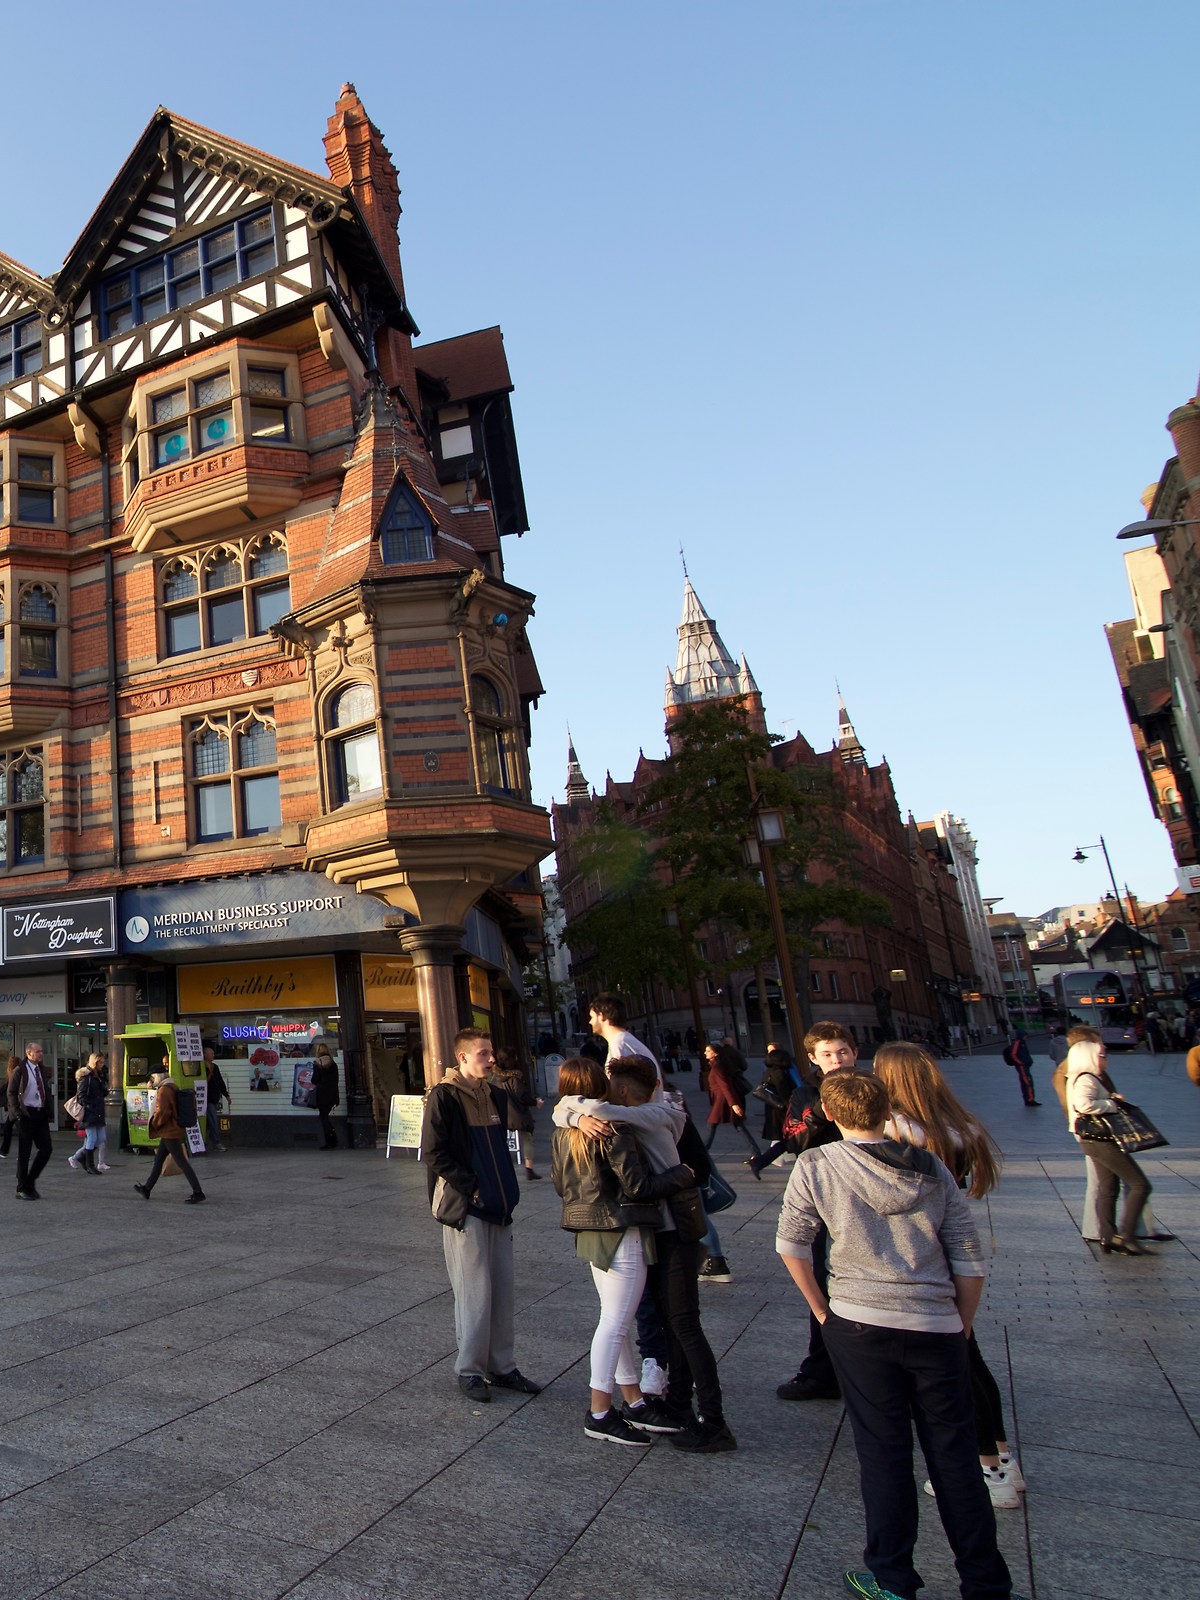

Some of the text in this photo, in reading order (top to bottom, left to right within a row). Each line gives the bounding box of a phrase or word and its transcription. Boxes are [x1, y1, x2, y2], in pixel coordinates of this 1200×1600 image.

[154, 896, 343, 927] MERIDIAN BUSINESS SUPPORT
[13, 912, 75, 937] The Nottingham
[154, 917, 290, 939] THE RECRUITMENT SPECIALIST
[48, 926, 104, 949] Doughnut
[210, 971, 296, 1001] Raithby's
[364, 965, 416, 987] Raith
[222, 1025, 257, 1040] SLUSH
[271, 1023, 307, 1033] WHIPPY
